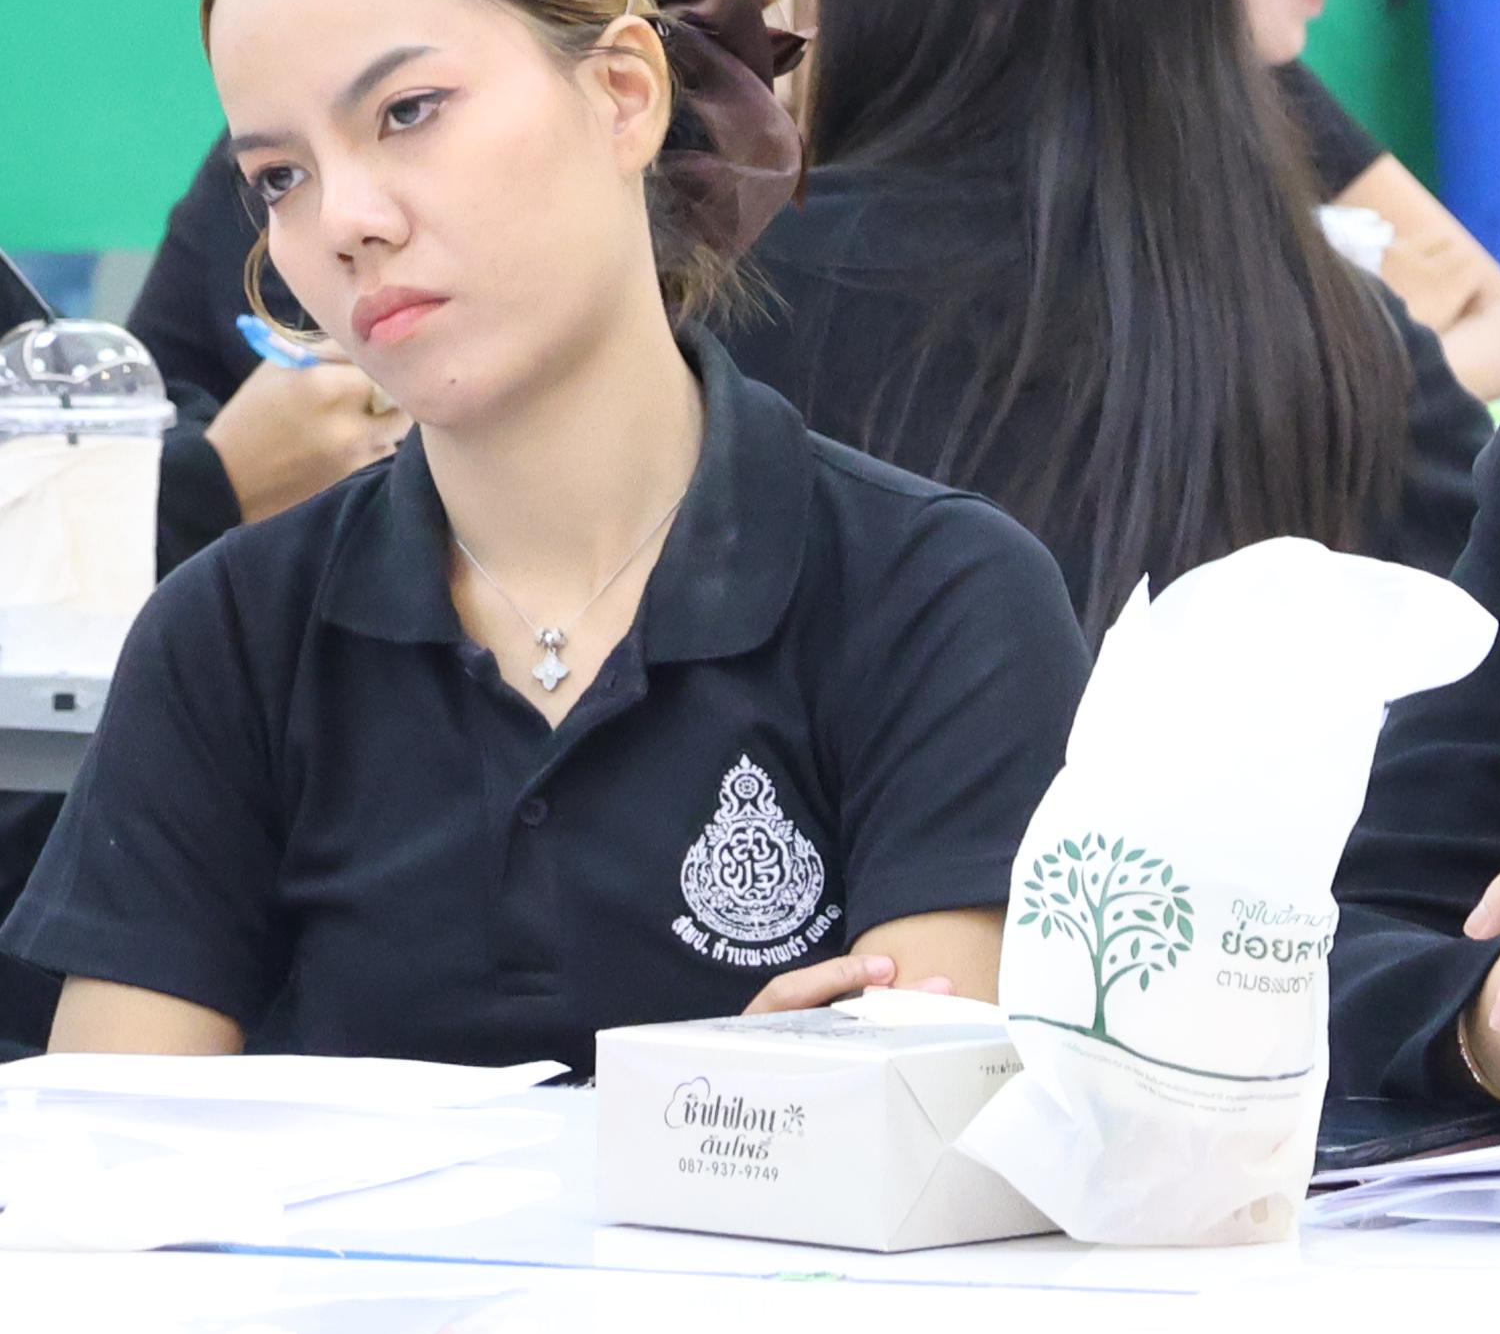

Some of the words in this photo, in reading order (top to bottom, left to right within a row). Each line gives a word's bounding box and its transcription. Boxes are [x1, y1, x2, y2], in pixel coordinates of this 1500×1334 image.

[712, 936, 808, 966] กำแพงเพชร
[678, 1157, 779, 1183] 087-937-9749
